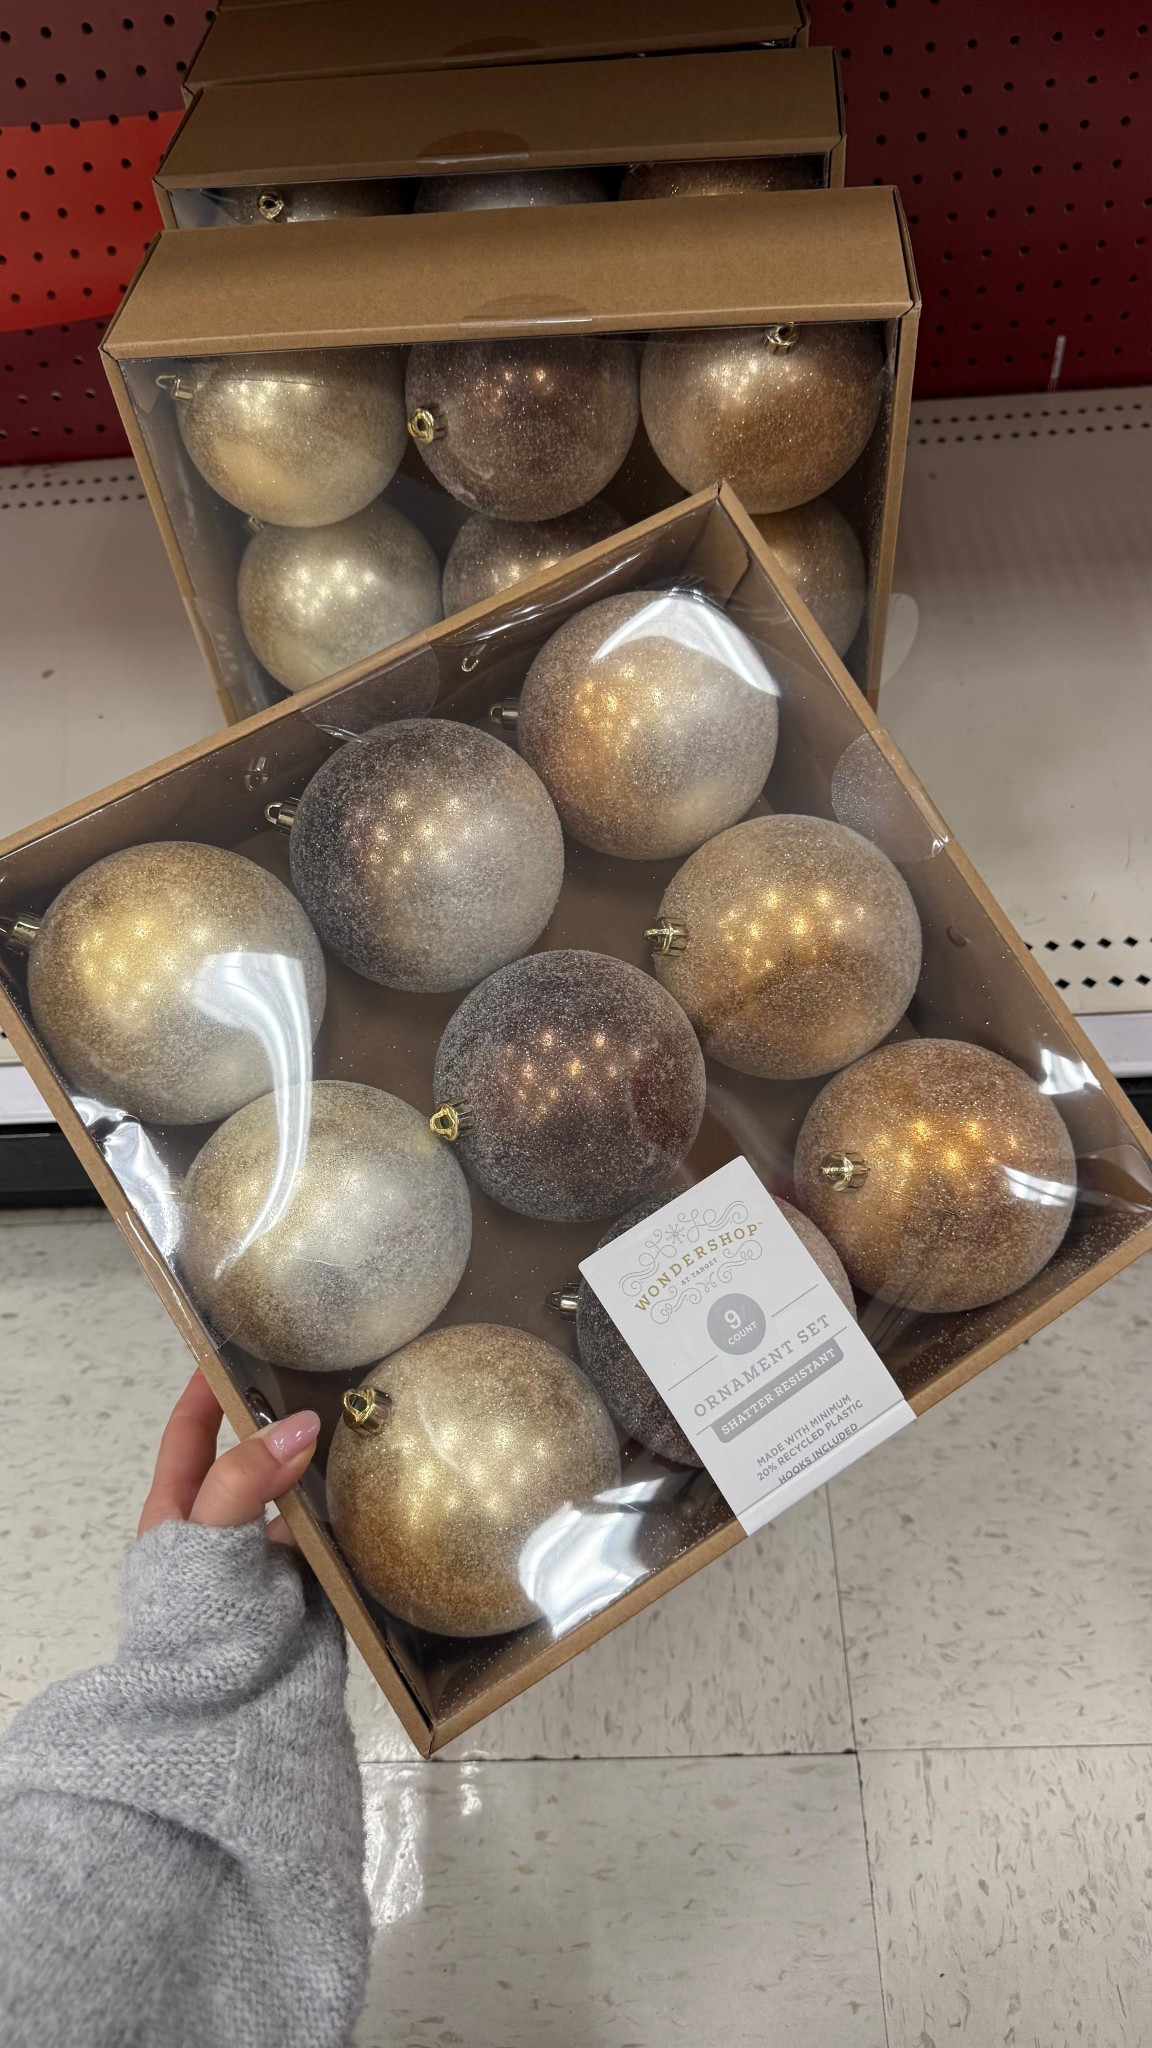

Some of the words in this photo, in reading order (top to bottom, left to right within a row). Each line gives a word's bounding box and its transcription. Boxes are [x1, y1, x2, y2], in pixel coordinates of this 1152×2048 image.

[634, 1223, 758, 1312] WONDERSHOP
[681, 1276, 690, 1285] AT
[691, 1257, 718, 1278] TARGET
[724, 1309, 742, 1330] 9
[728, 1320, 757, 1345] COUNT
[694, 1340, 794, 1417] ORNAMENT
[797, 1314, 830, 1344] SET
[721, 1393, 774, 1435] SHATTER
[773, 1347, 836, 1397] RESISTANT
[756, 1443, 785, 1467] MADE
[784, 1424, 810, 1446] WITH
[809, 1394, 852, 1428] MINIMUM
[757, 1462, 778, 1481] 20%
[777, 1428, 825, 1466] RECYCLED
[825, 1400, 863, 1431] PLASTIC
[778, 1457, 812, 1485] HOOKS
[812, 1423, 858, 1460] INCLUDED
